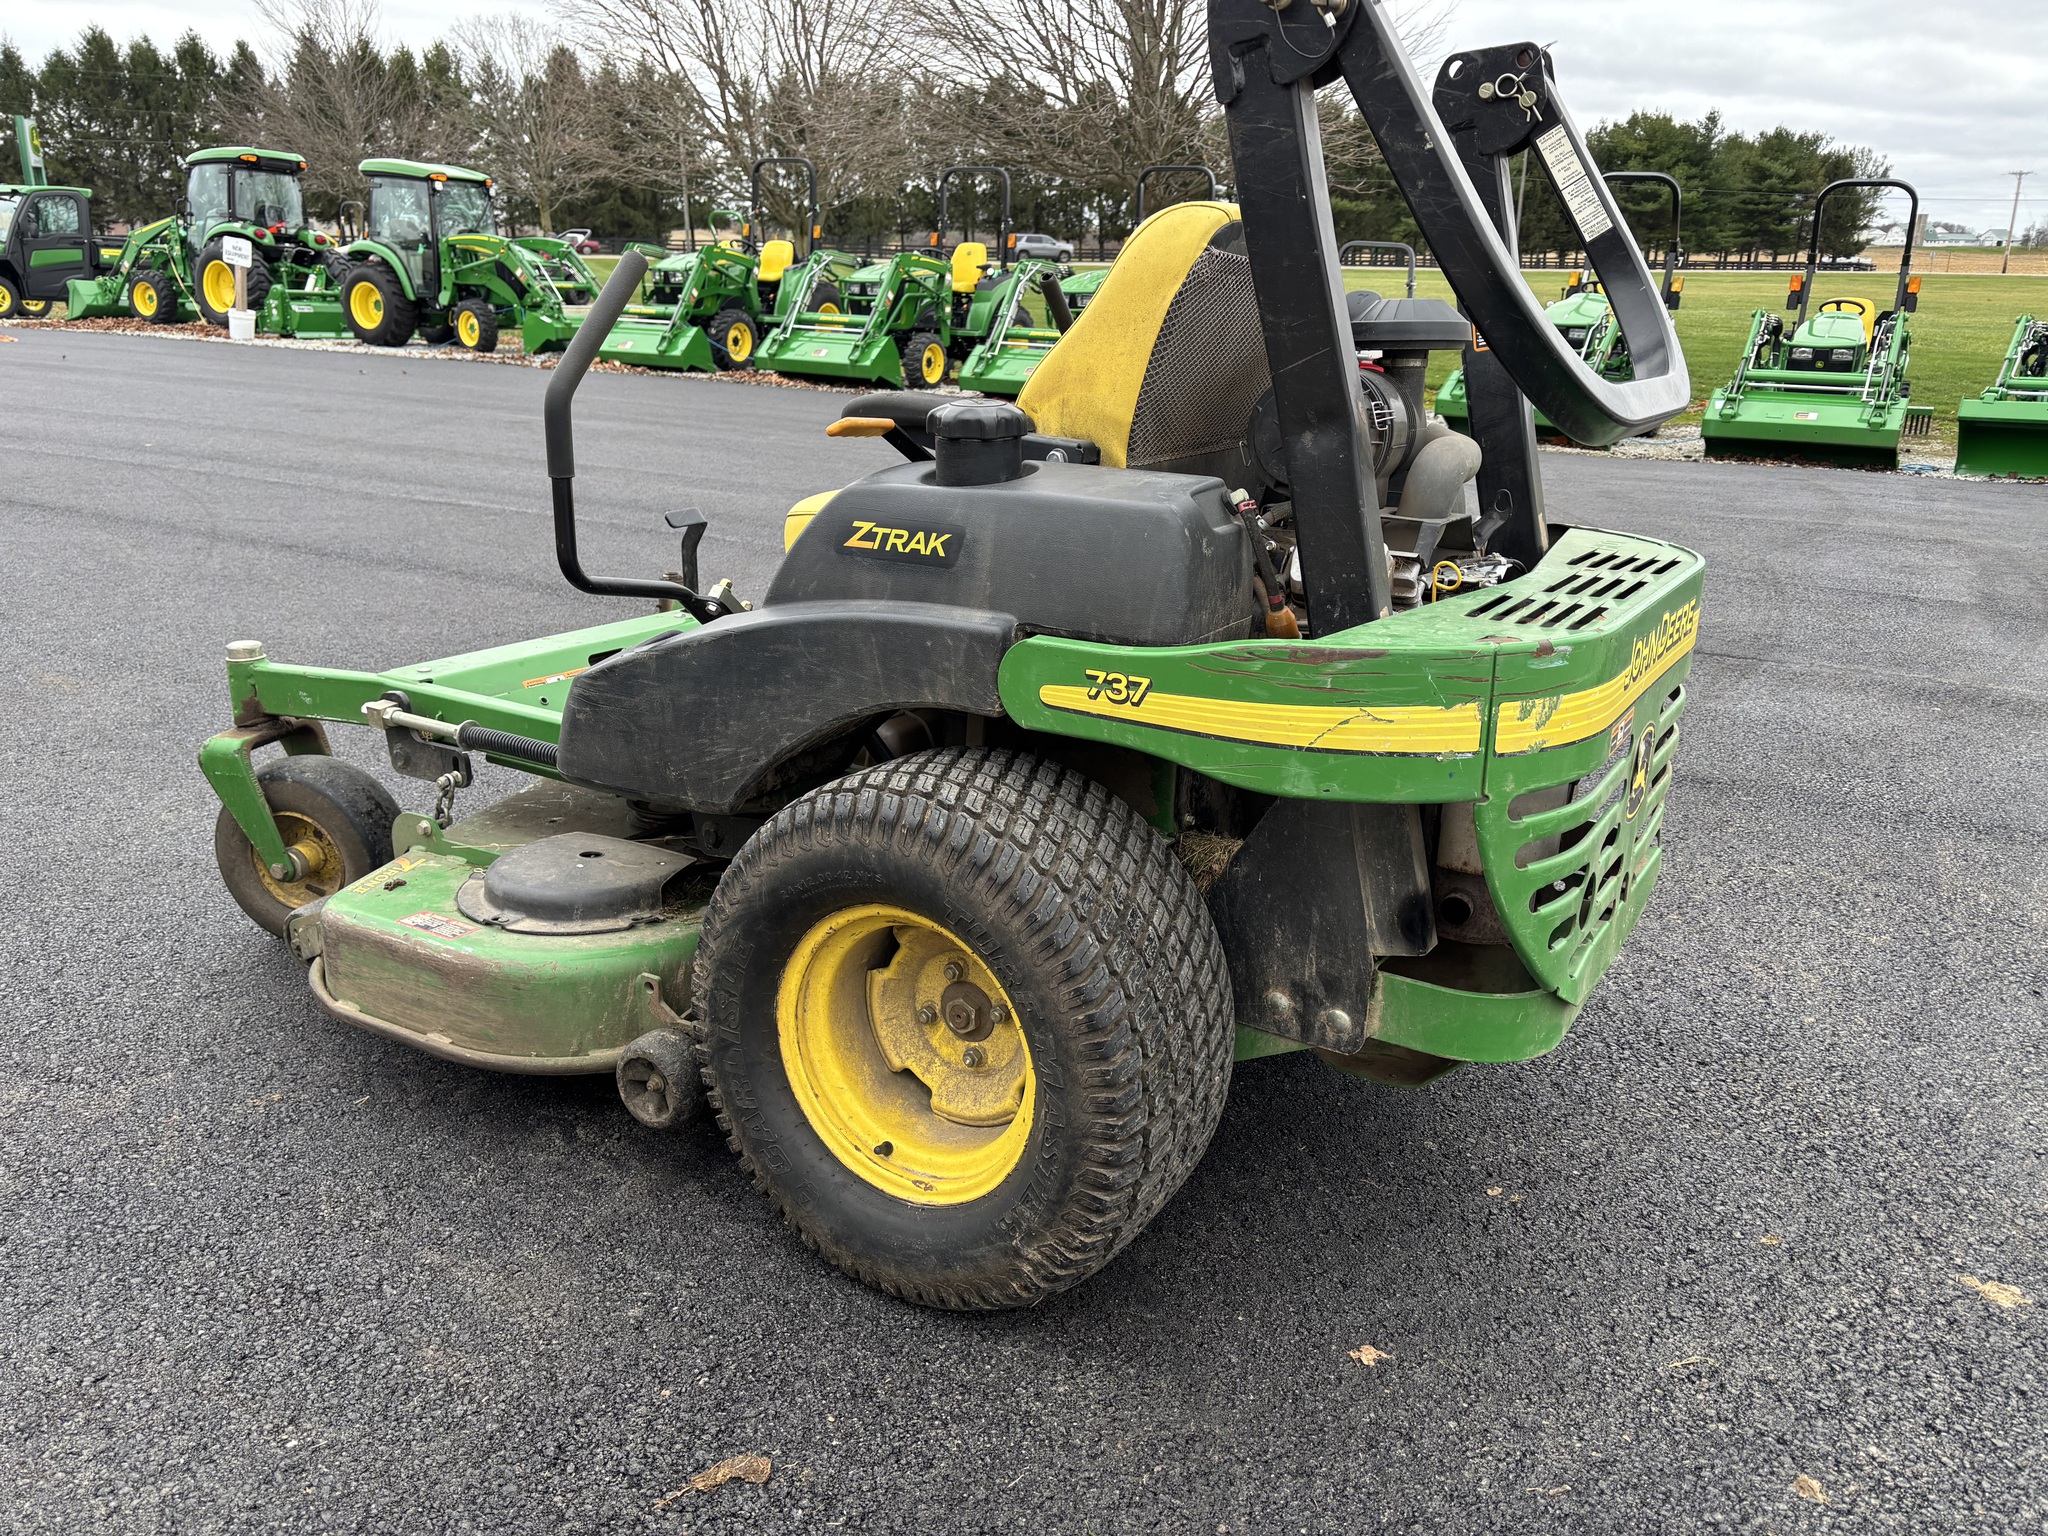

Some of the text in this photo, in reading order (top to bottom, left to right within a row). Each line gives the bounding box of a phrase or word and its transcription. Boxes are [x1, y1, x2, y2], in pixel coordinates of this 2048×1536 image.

[843, 520, 953, 557] ZTRAK
[1623, 597, 1697, 691] JOHN DEERE
[1085, 668, 1153, 707] 737
